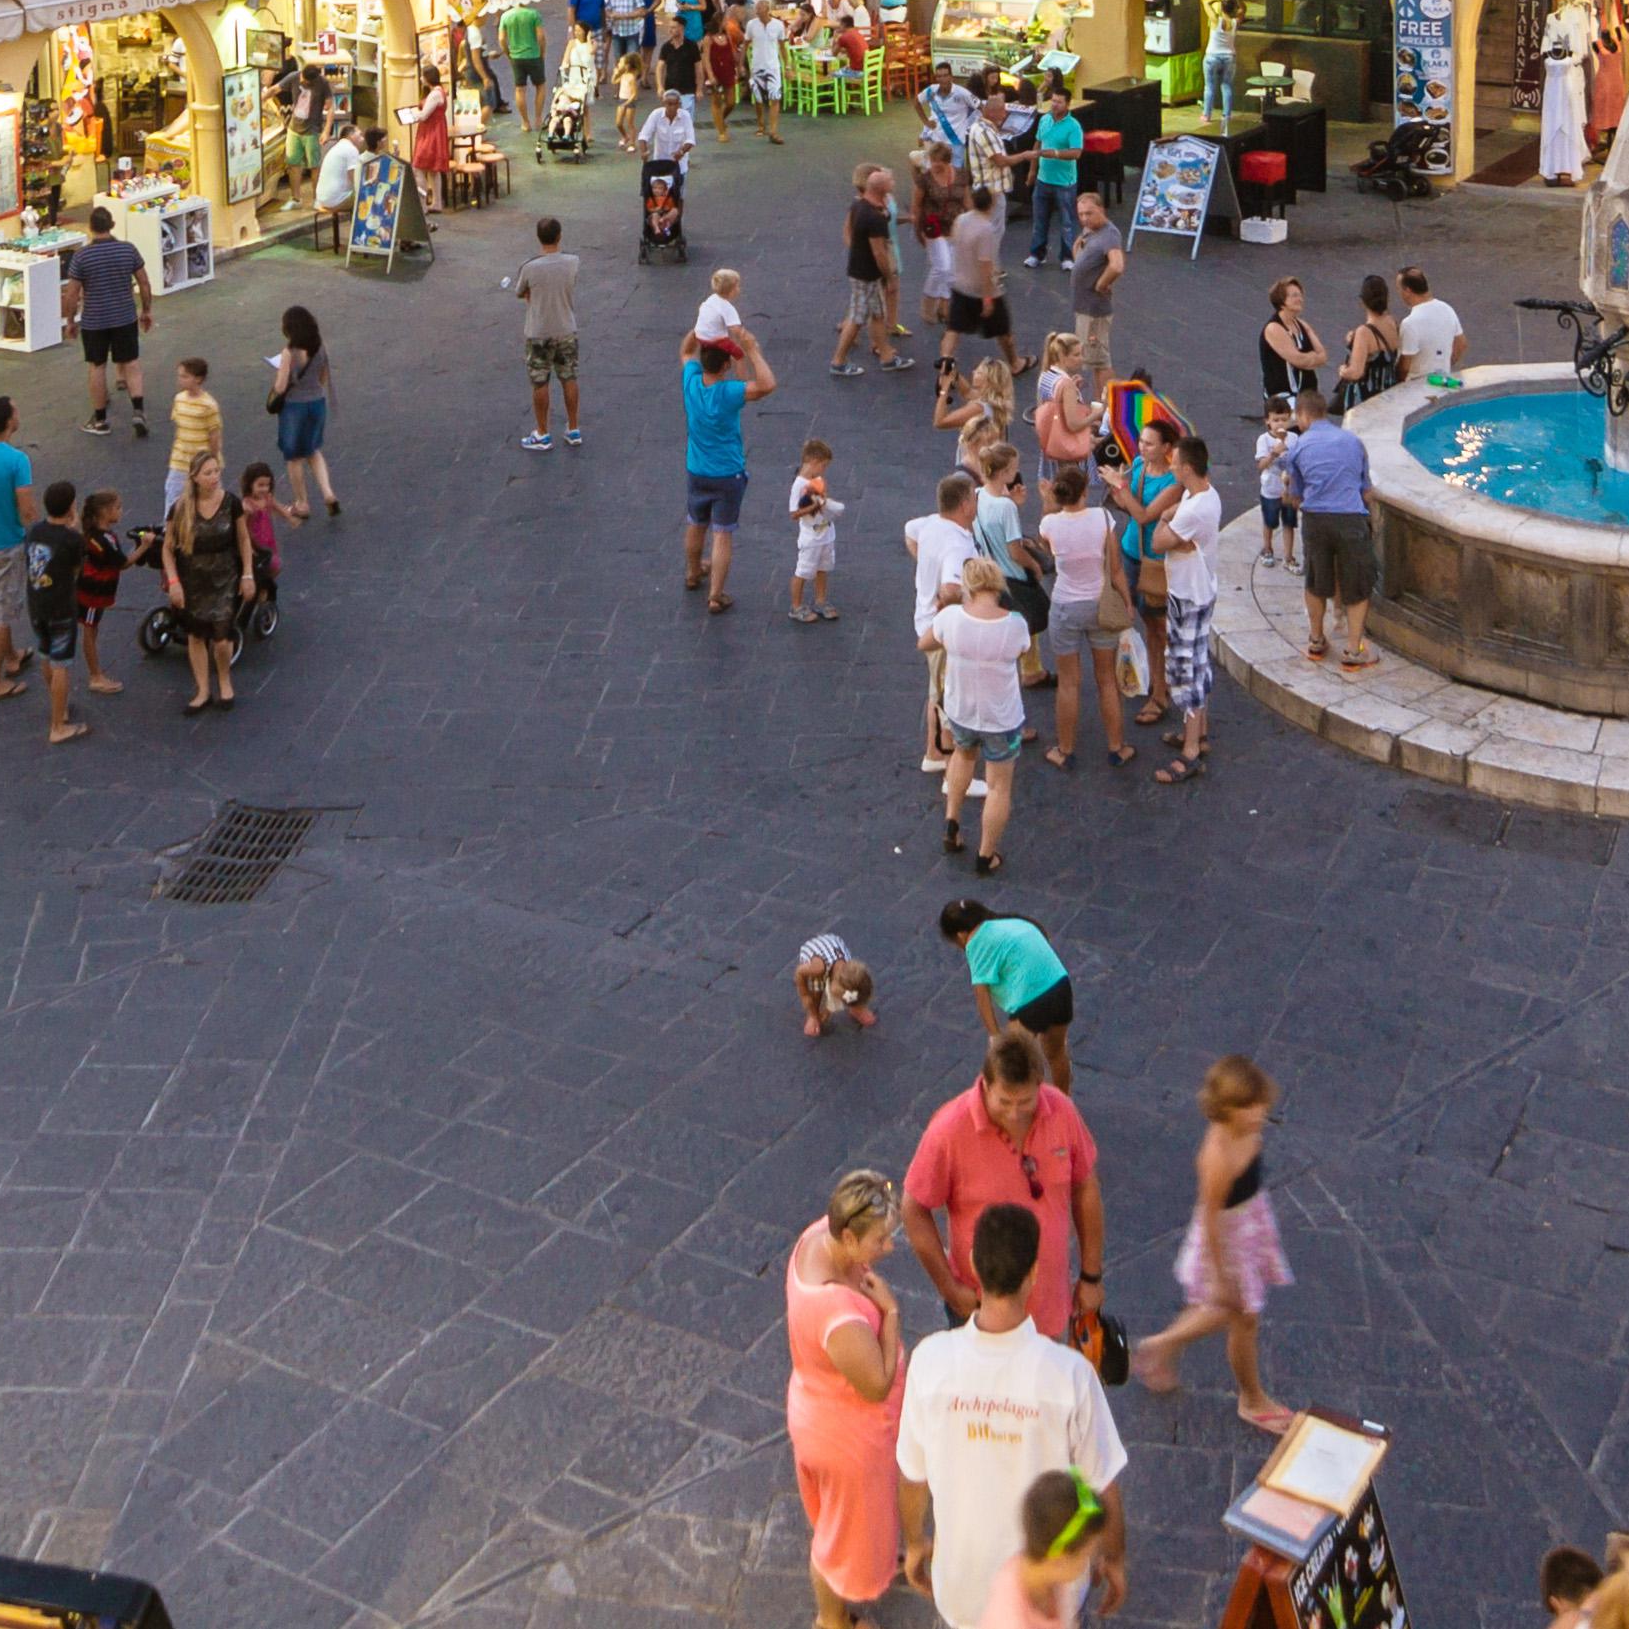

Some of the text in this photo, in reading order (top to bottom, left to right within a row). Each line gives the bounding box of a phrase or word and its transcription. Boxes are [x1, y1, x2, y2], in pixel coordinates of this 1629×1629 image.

[1399, 19, 1443, 36] FREE
[1530, 0, 1541, 49] PLAKA
[1398, 34, 1445, 46] WIRELESS
[1422, 59, 1449, 69] PLAKA
[948, 1395, 1040, 1421] Archipelagos
